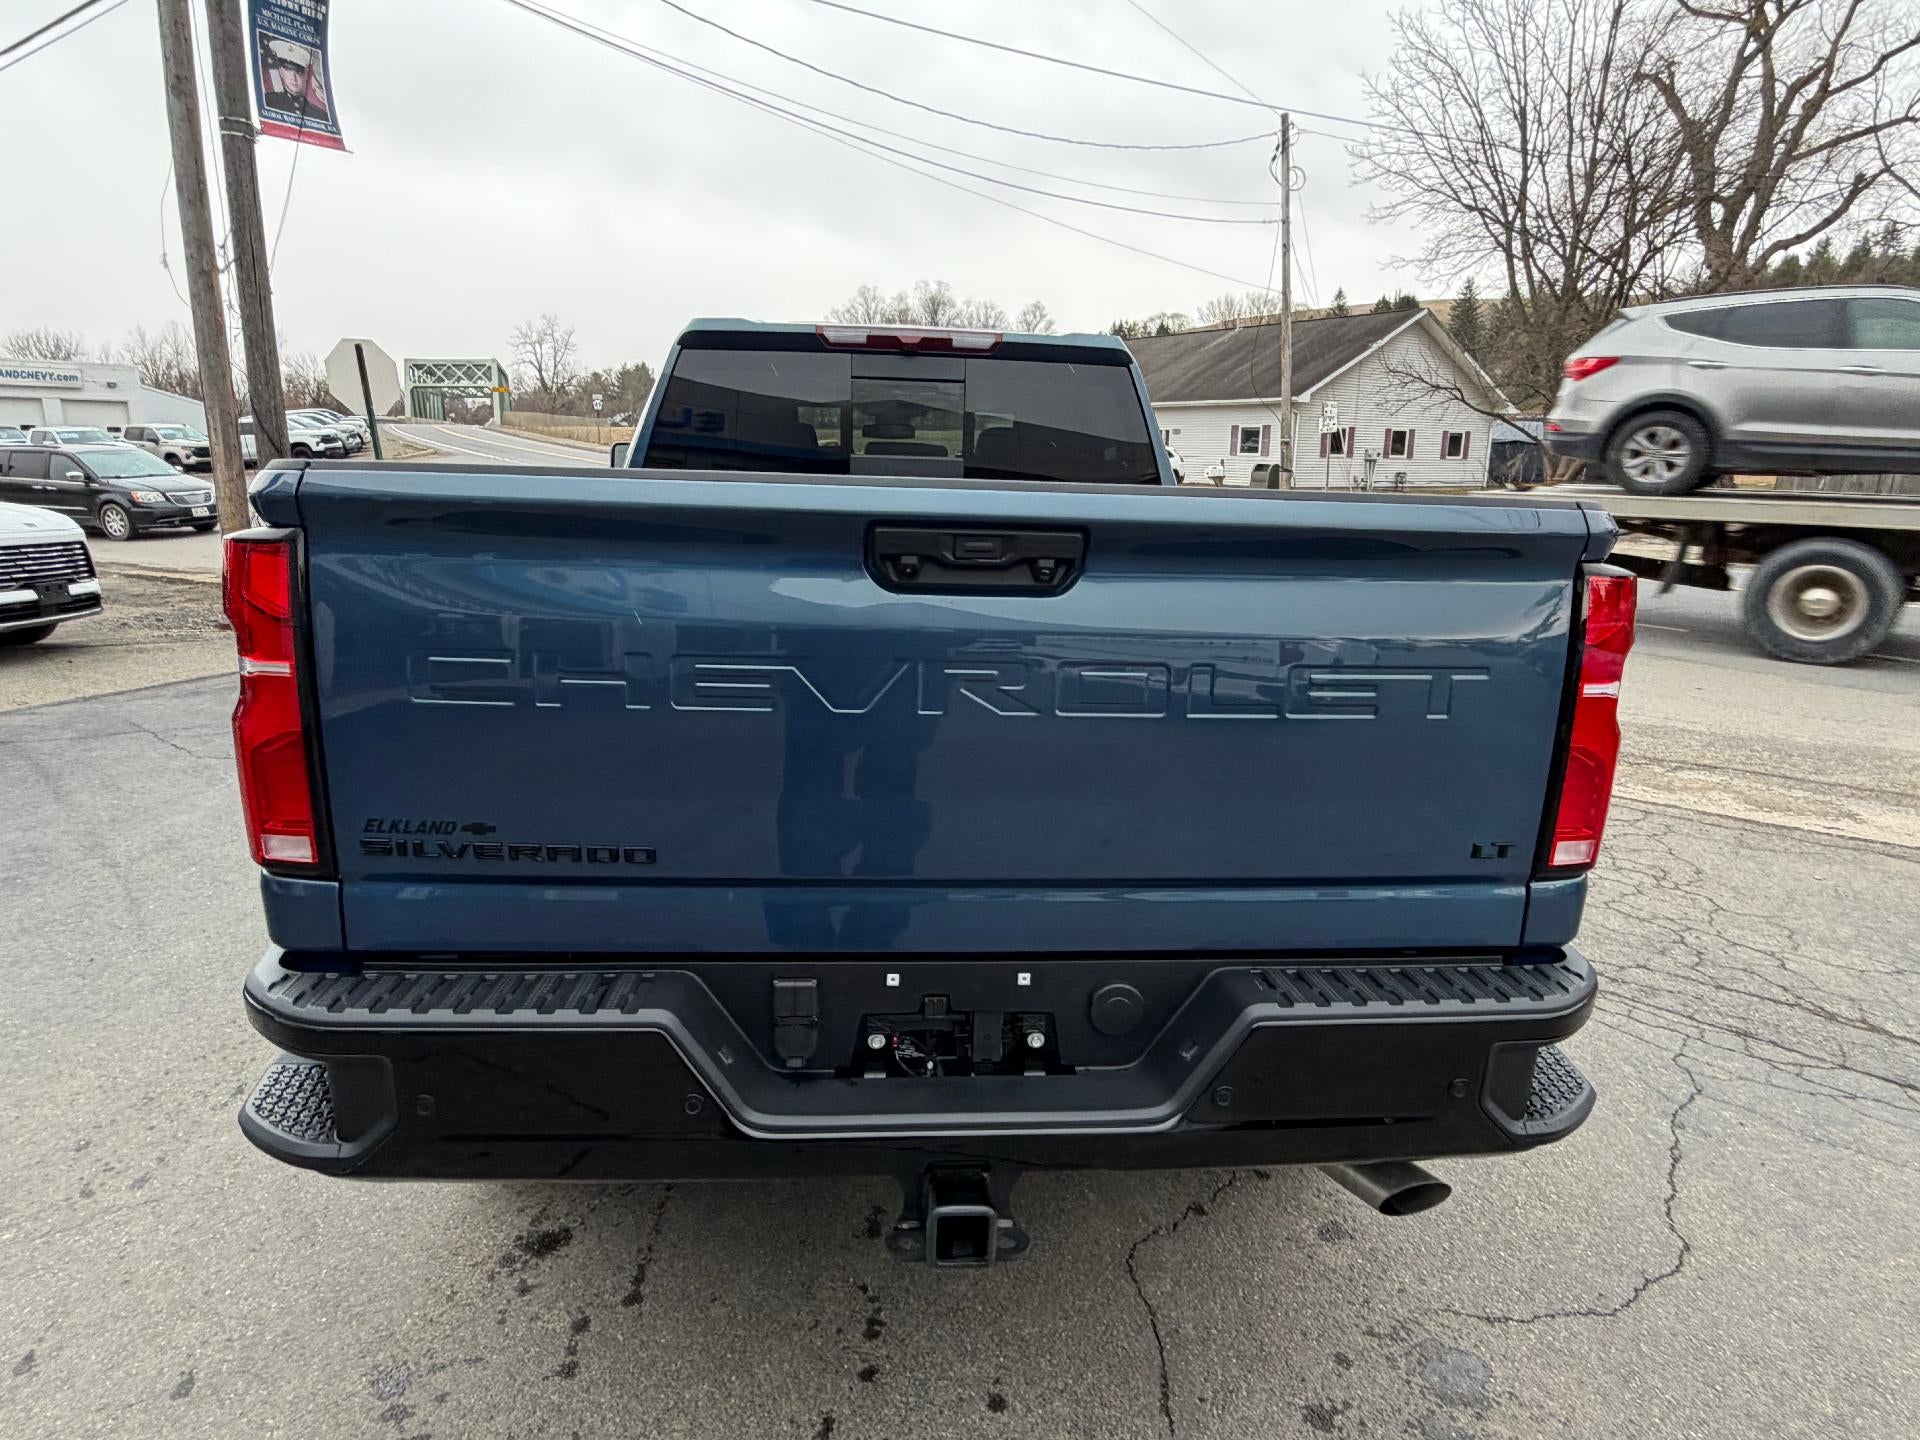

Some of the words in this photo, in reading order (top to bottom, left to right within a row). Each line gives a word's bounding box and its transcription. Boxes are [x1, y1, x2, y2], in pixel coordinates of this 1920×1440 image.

[270, 20, 298, 37] MARINE
[406, 648, 1490, 719] CHEVROLET
[362, 818, 457, 835] ELKLAND
[359, 837, 657, 865] SILVERADO
[1470, 842, 1517, 859] LT
